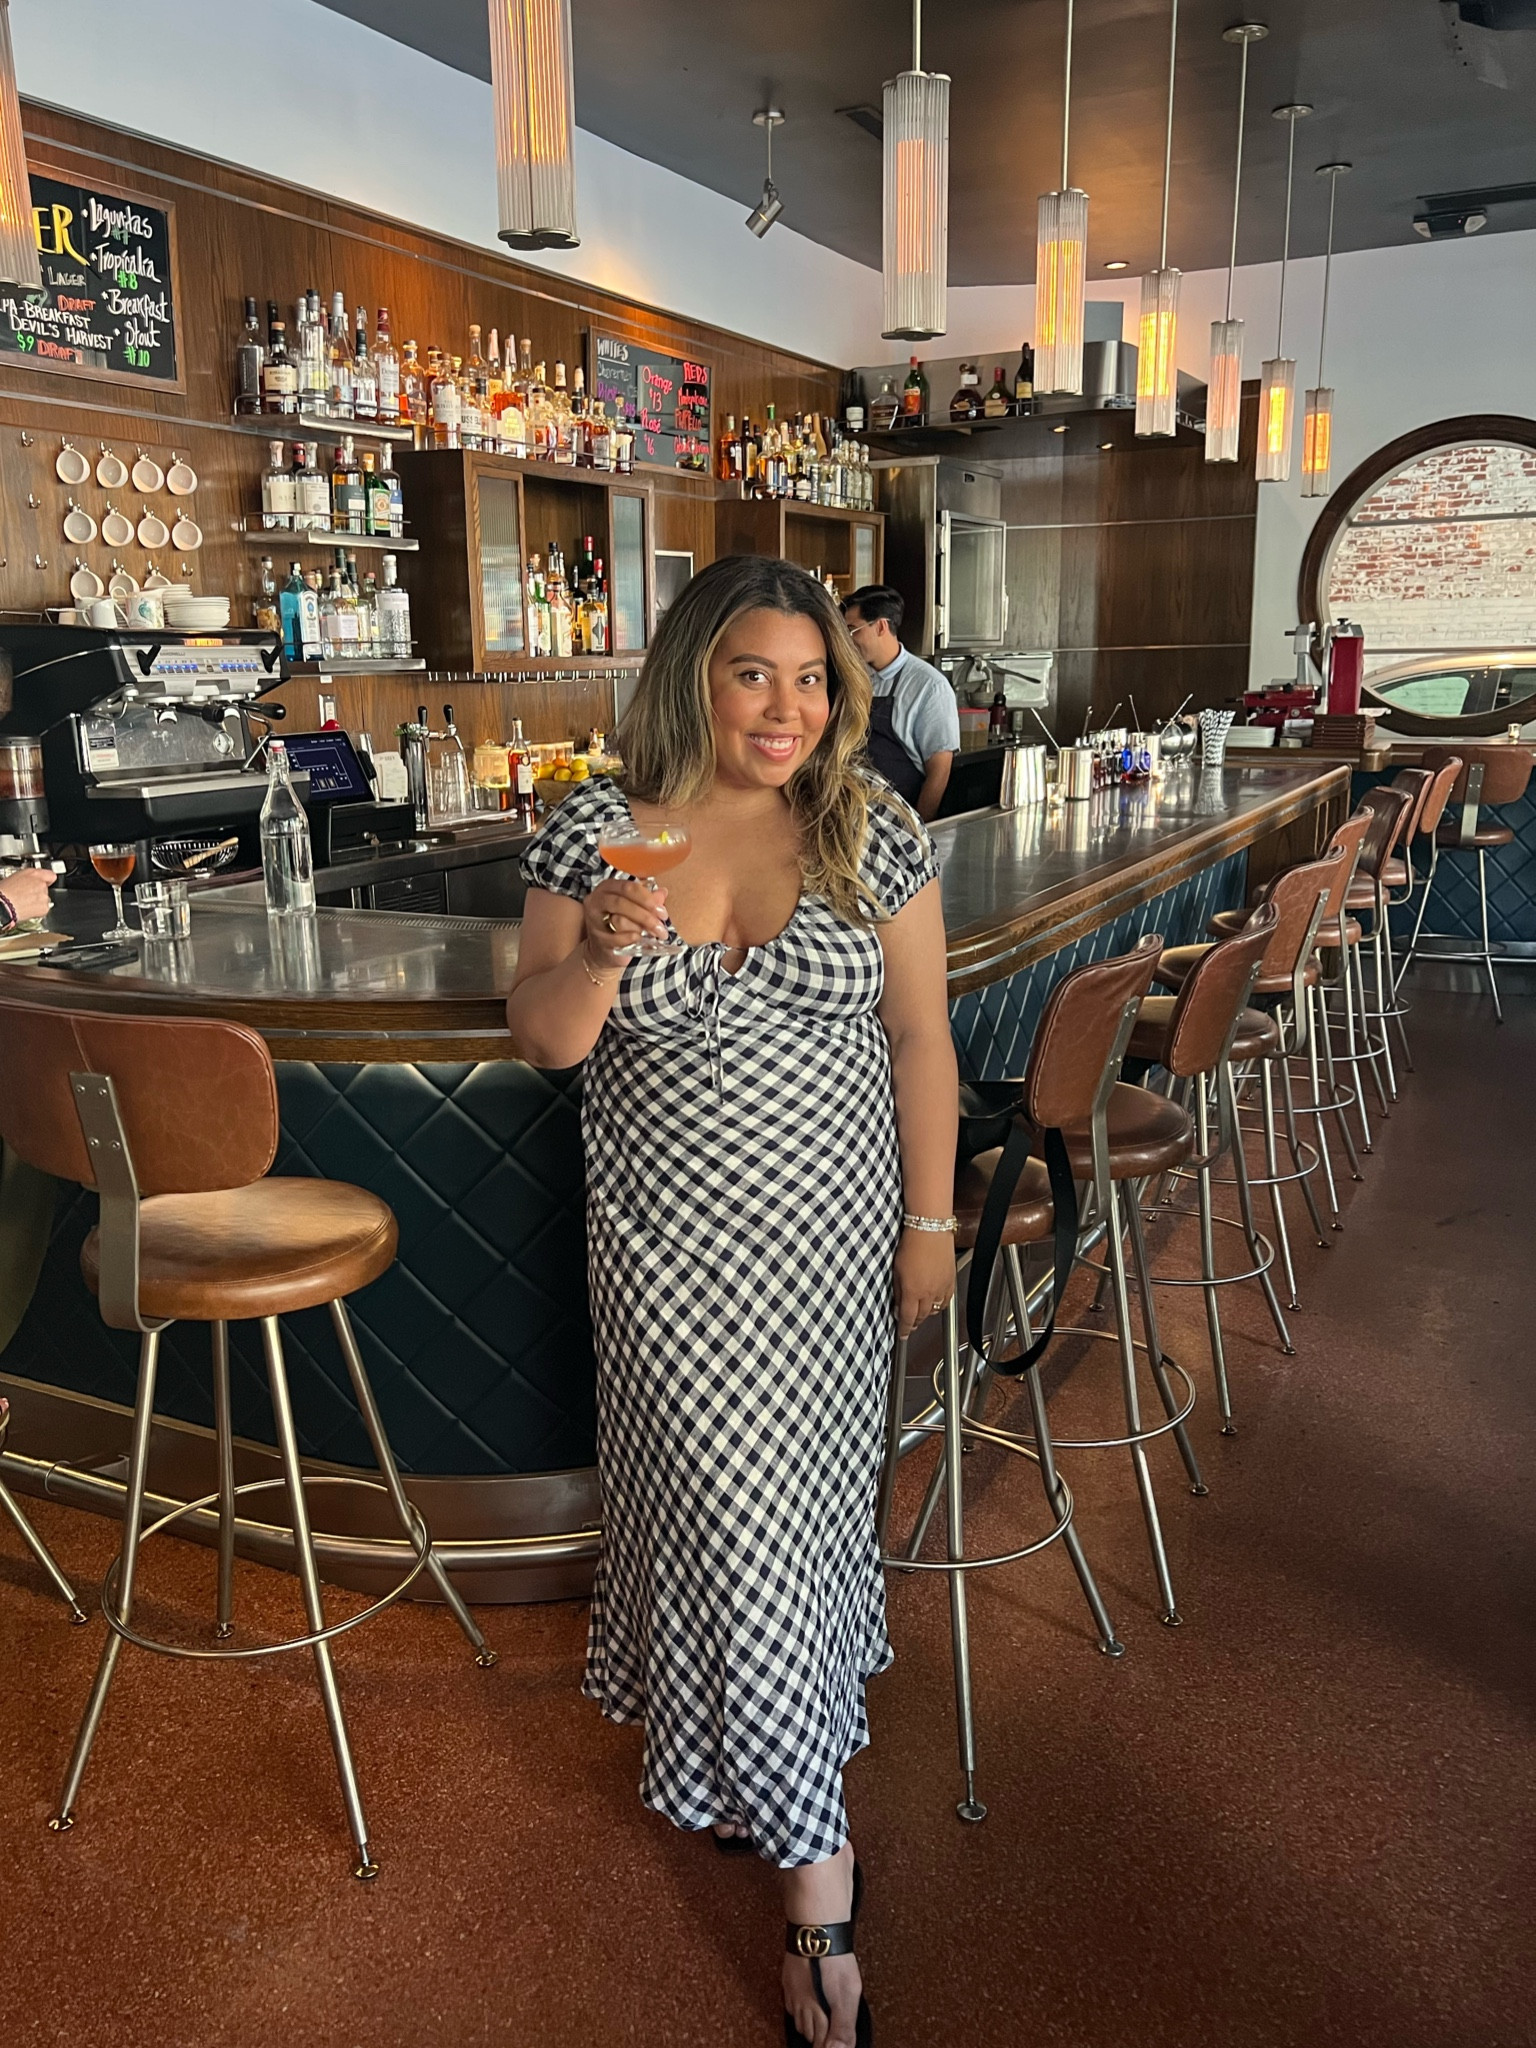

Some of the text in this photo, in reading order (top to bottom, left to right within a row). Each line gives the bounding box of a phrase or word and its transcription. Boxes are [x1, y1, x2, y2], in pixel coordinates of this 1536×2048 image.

[47, 265, 87, 287] LAGER
[57, 294, 97, 312] DRAFT
[107, 288, 170, 327] Breakfast
[9, 313, 114, 351] DEVIL'S HARVEST
[16, 331, 35, 352] $9
[124, 317, 161, 349] Stout
[642, 366, 673, 395] Orange
[683, 361, 708, 384] REDS
